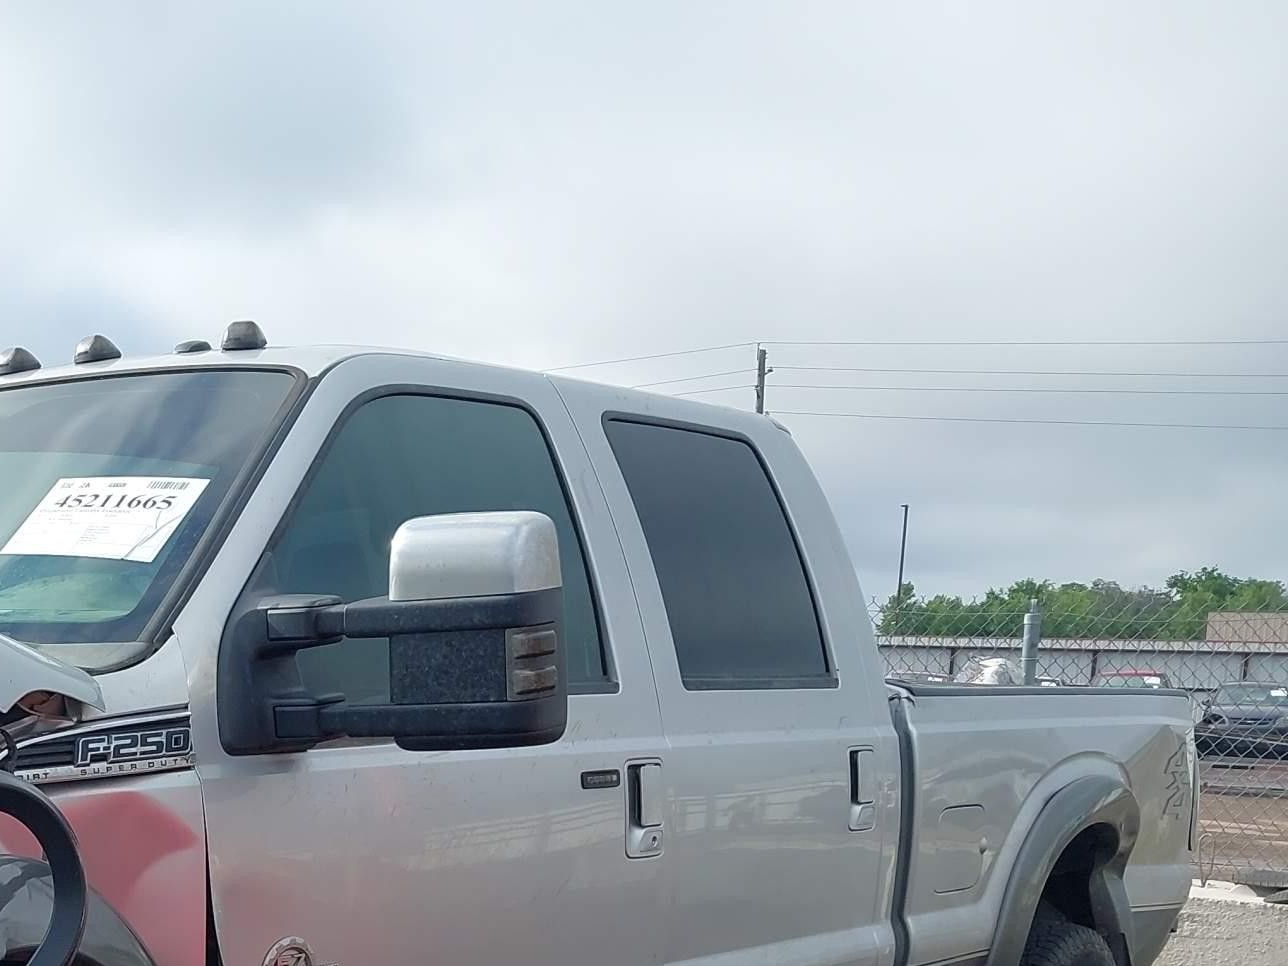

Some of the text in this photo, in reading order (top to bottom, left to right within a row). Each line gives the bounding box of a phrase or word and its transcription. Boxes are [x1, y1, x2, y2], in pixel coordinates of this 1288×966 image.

[55, 494, 177, 510] 45211665
[78, 728, 192, 764] F-250
[80, 763, 137, 776] SUPER
[147, 756, 190, 769] DUTY
